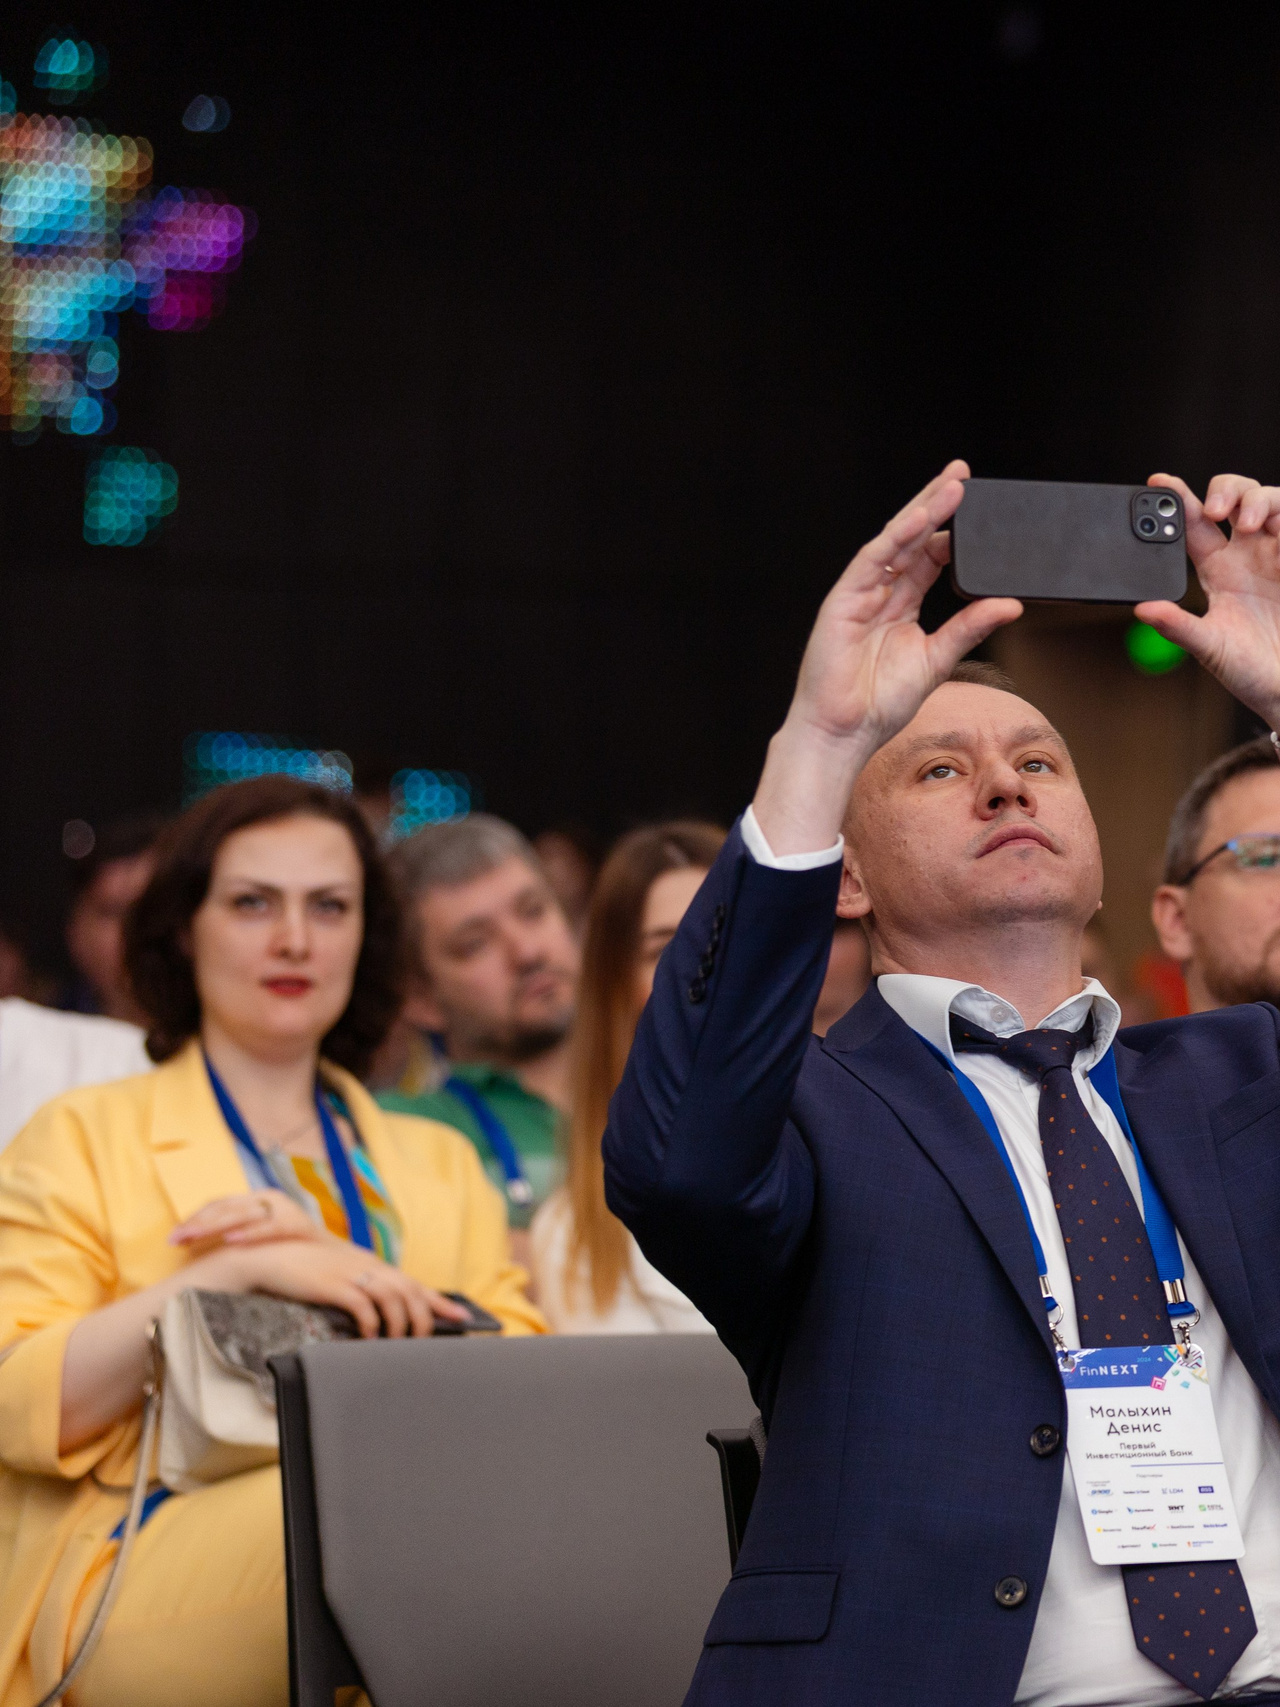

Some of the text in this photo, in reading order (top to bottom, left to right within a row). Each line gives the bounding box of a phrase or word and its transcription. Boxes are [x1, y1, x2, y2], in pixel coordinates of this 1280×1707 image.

[1079, 1364, 1139, 1376] FinNEXT
[1090, 1405, 1172, 1418] Малыхин
[1107, 1421, 1162, 1436] Денис
[1119, 1442, 1156, 1450] Первый
[1086, 1449, 1194, 1460] Инвестиционный Банк
